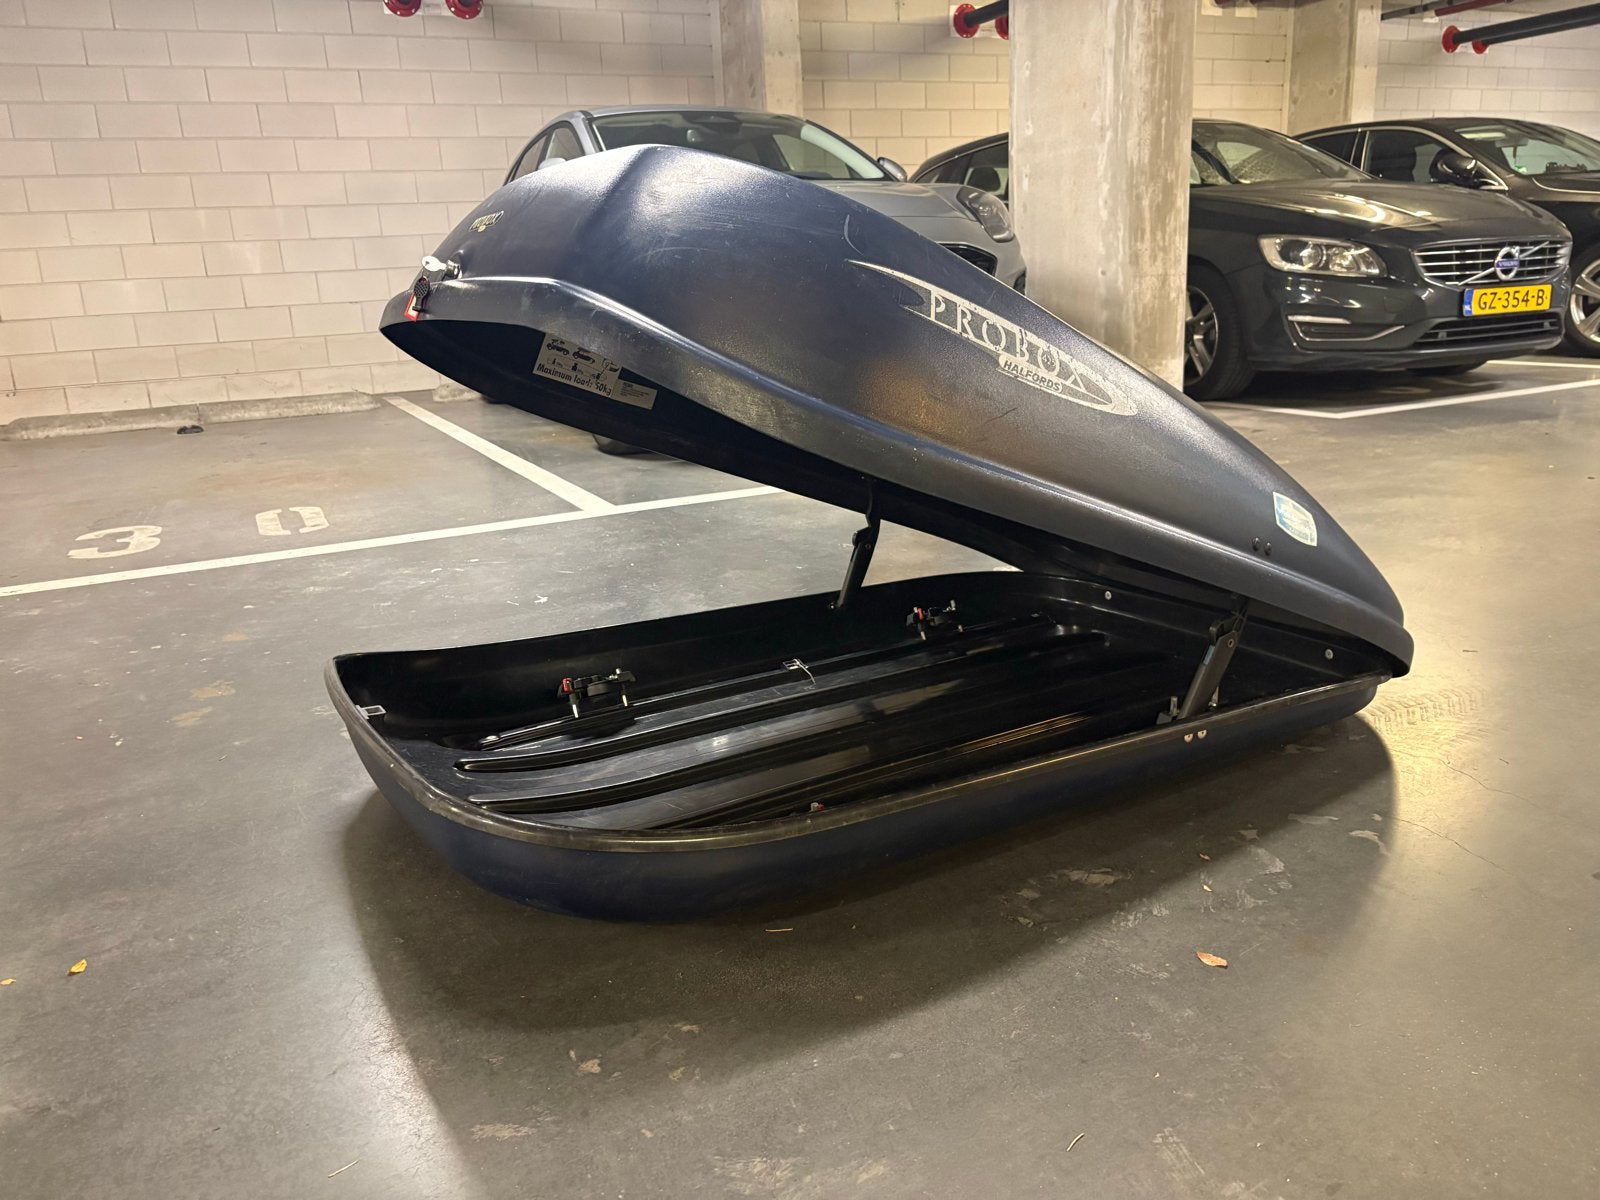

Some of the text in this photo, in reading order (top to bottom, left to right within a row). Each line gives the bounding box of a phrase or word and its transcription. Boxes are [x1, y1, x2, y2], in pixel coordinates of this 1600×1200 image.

[1478, 289, 1545, 310] GZ-354-B
[931, 289, 1088, 392] PROBOX
[537, 363, 573, 382] Maximum
[595, 383, 612, 397] 50kg
[1003, 360, 1061, 393] HALFORDS
